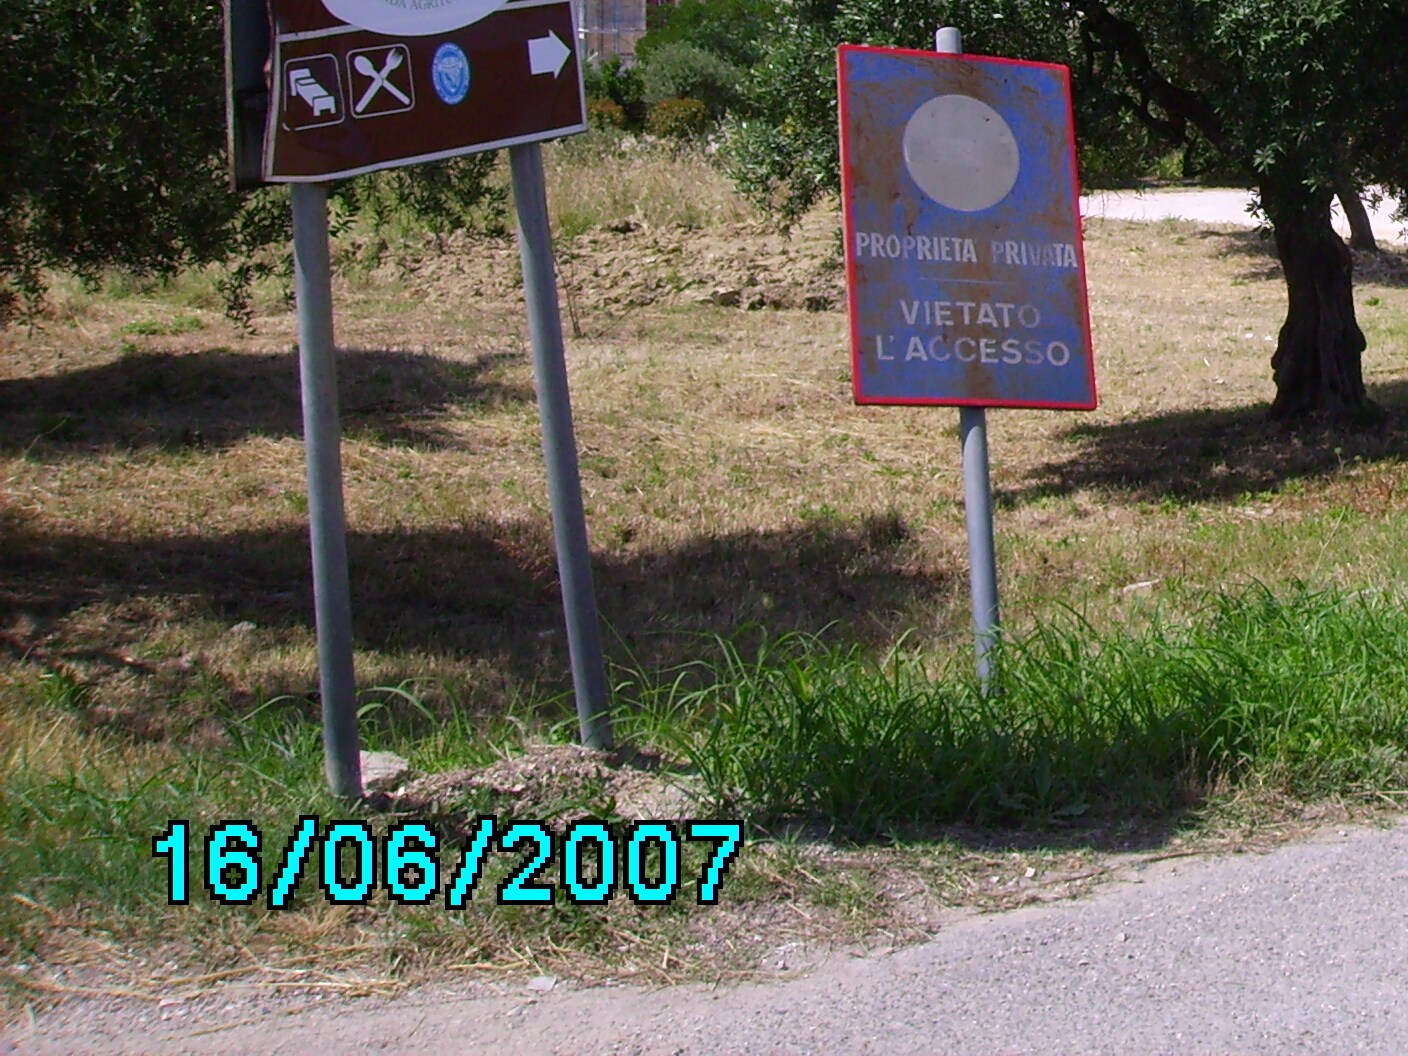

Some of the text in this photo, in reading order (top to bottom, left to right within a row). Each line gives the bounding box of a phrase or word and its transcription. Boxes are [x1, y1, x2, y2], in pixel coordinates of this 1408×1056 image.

[856, 232, 1079, 268] PROPRIETA PRIVATA
[900, 300, 1041, 329] VIETATO
